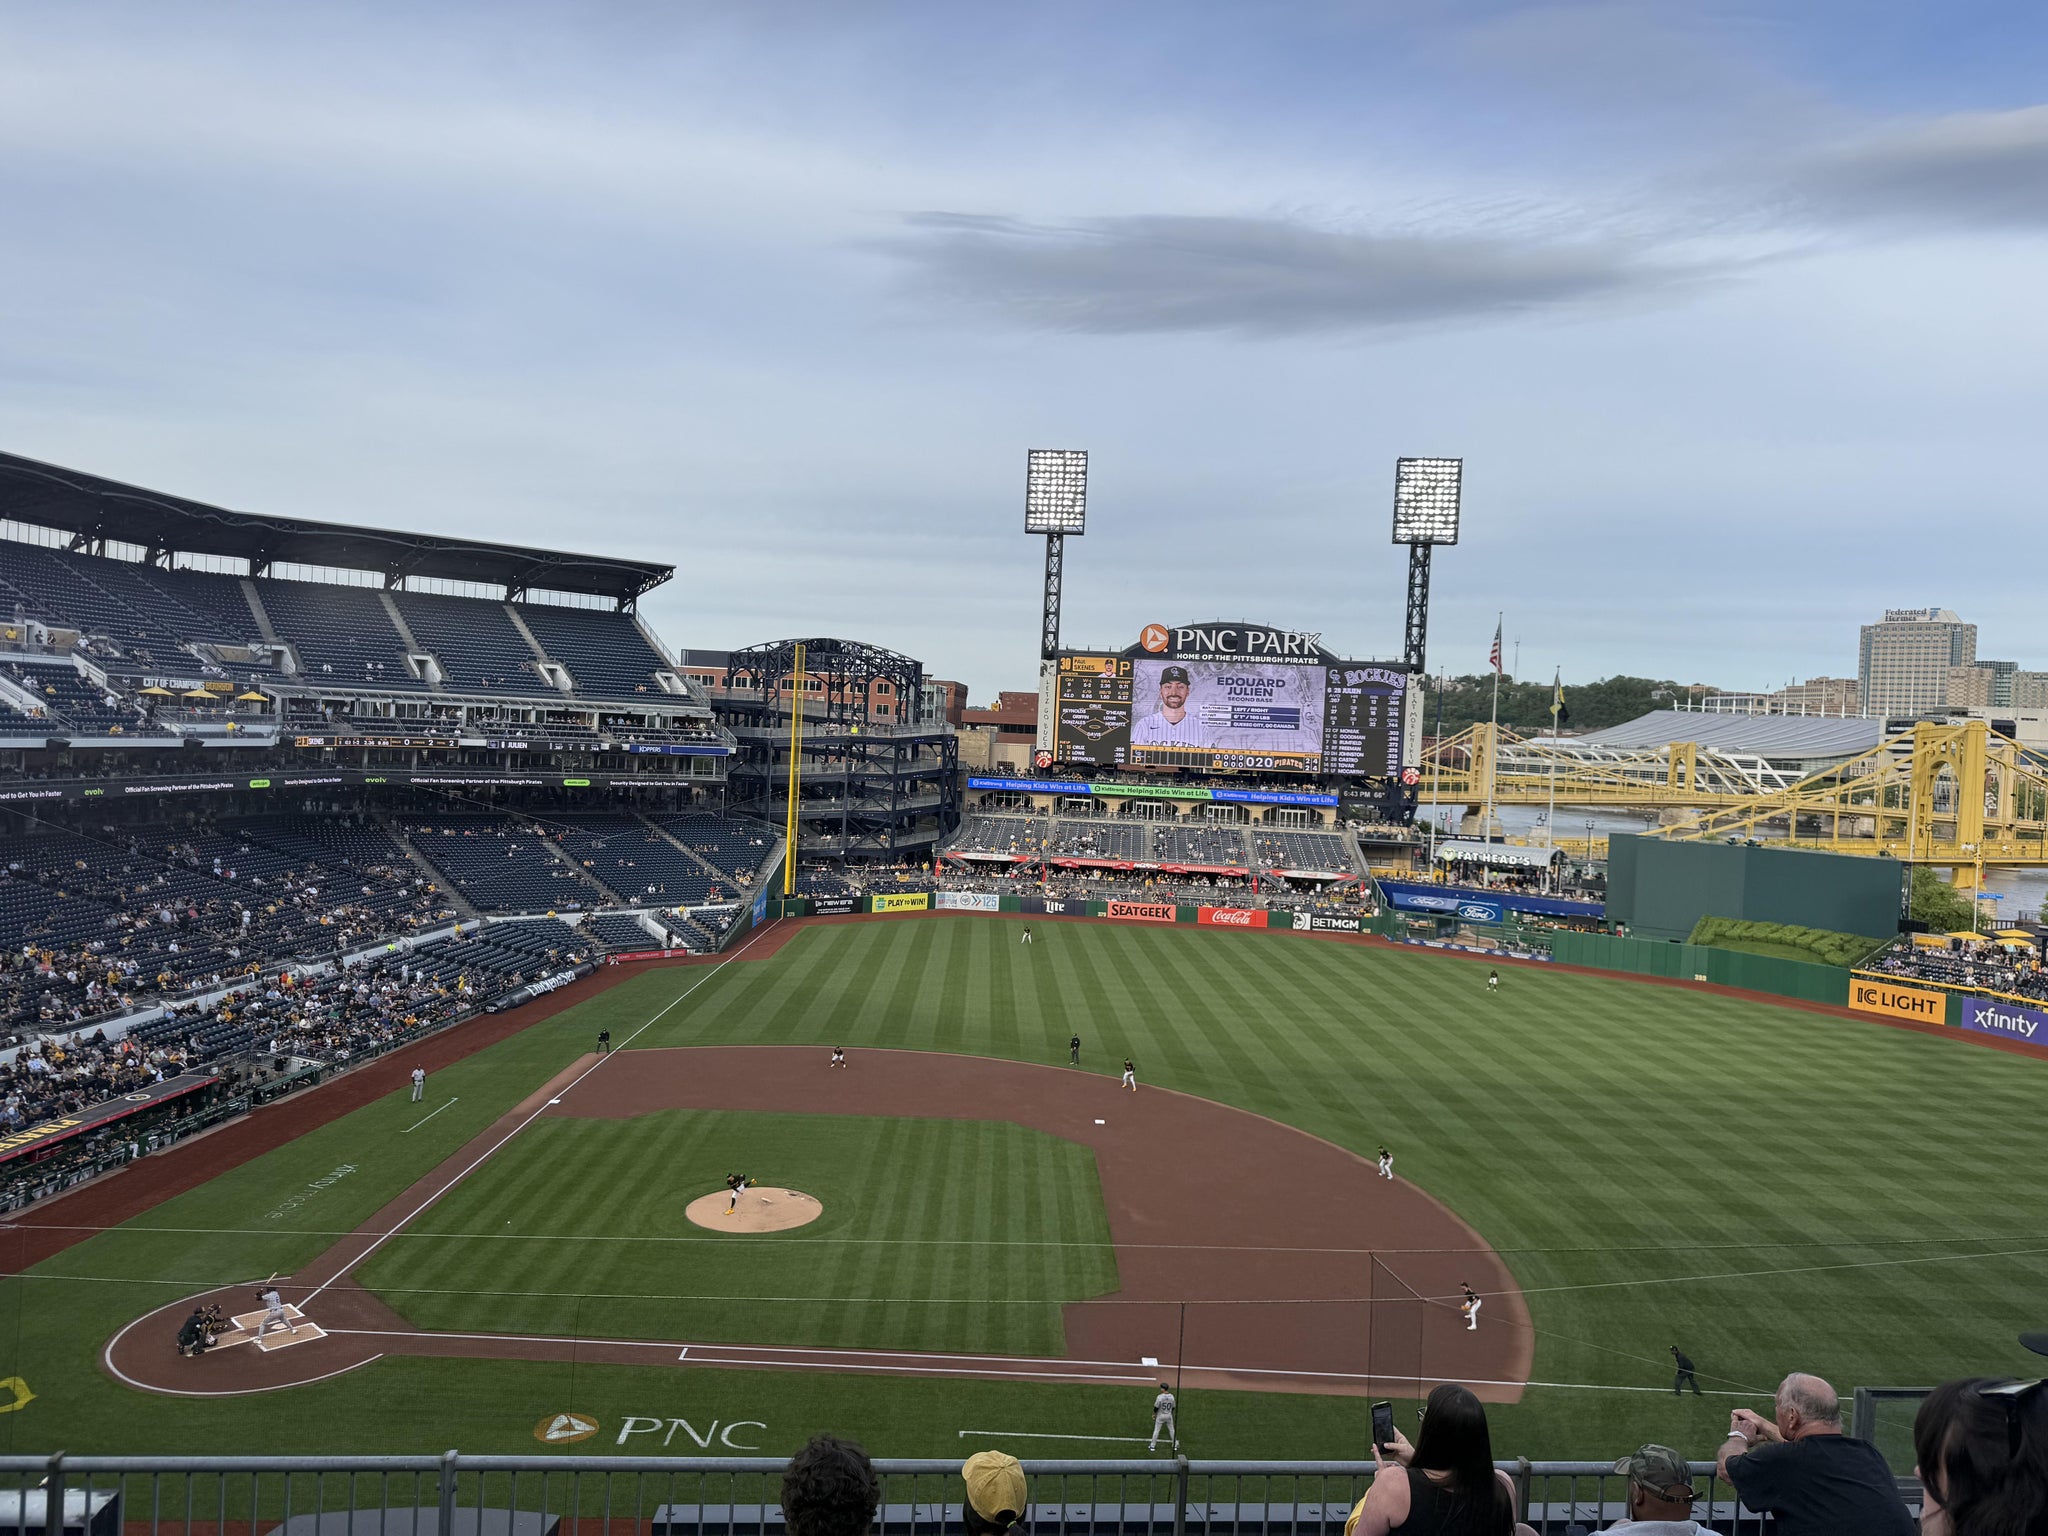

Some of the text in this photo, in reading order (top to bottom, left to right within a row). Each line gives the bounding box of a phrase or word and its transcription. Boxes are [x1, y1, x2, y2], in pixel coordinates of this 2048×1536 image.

[1175, 628, 1322, 656] PNC PARK
[1060, 657, 1071, 670] 30
[1232, 655, 1282, 663] PITTSBURGH
[1285, 656, 1318, 665] PIRATES
[1119, 661, 1130, 675] P
[143, 678, 205, 689] CITY OF CHAMPIONS
[1217, 677, 1286, 688] EDOUARD
[1344, 668, 1407, 689] ROCKIES
[1227, 687, 1273, 697] JULIEN
[1274, 758, 1303, 769] PIRATES
[150, 785, 171, 793] Screening
[1006, 781, 1031, 789] Helping
[1127, 787, 1153, 795] Helping
[1251, 793, 1278, 802] Helping
[1457, 852, 1531, 866] FAT HEAD'S
[888, 899, 903, 907] PLAY
[911, 898, 925, 906] WIN!
[982, 895, 997, 907] 125
[1046, 901, 1065, 913] Lite
[1413, 898, 1437, 906] Ford
[1112, 904, 1171, 920] SEATGEEK
[1212, 909, 1253, 925] Coca-Cola
[1464, 907, 1489, 919] Ford
[1312, 917, 1359, 930] BETMGM
[1857, 987, 1937, 1014] IC LIGHT
[1974, 1007, 2038, 1037] xfinity
[0, 1119, 84, 1152] PIRATE
[1161, 1402, 1172, 1410] 50
[616, 1416, 767, 1450] PNC
